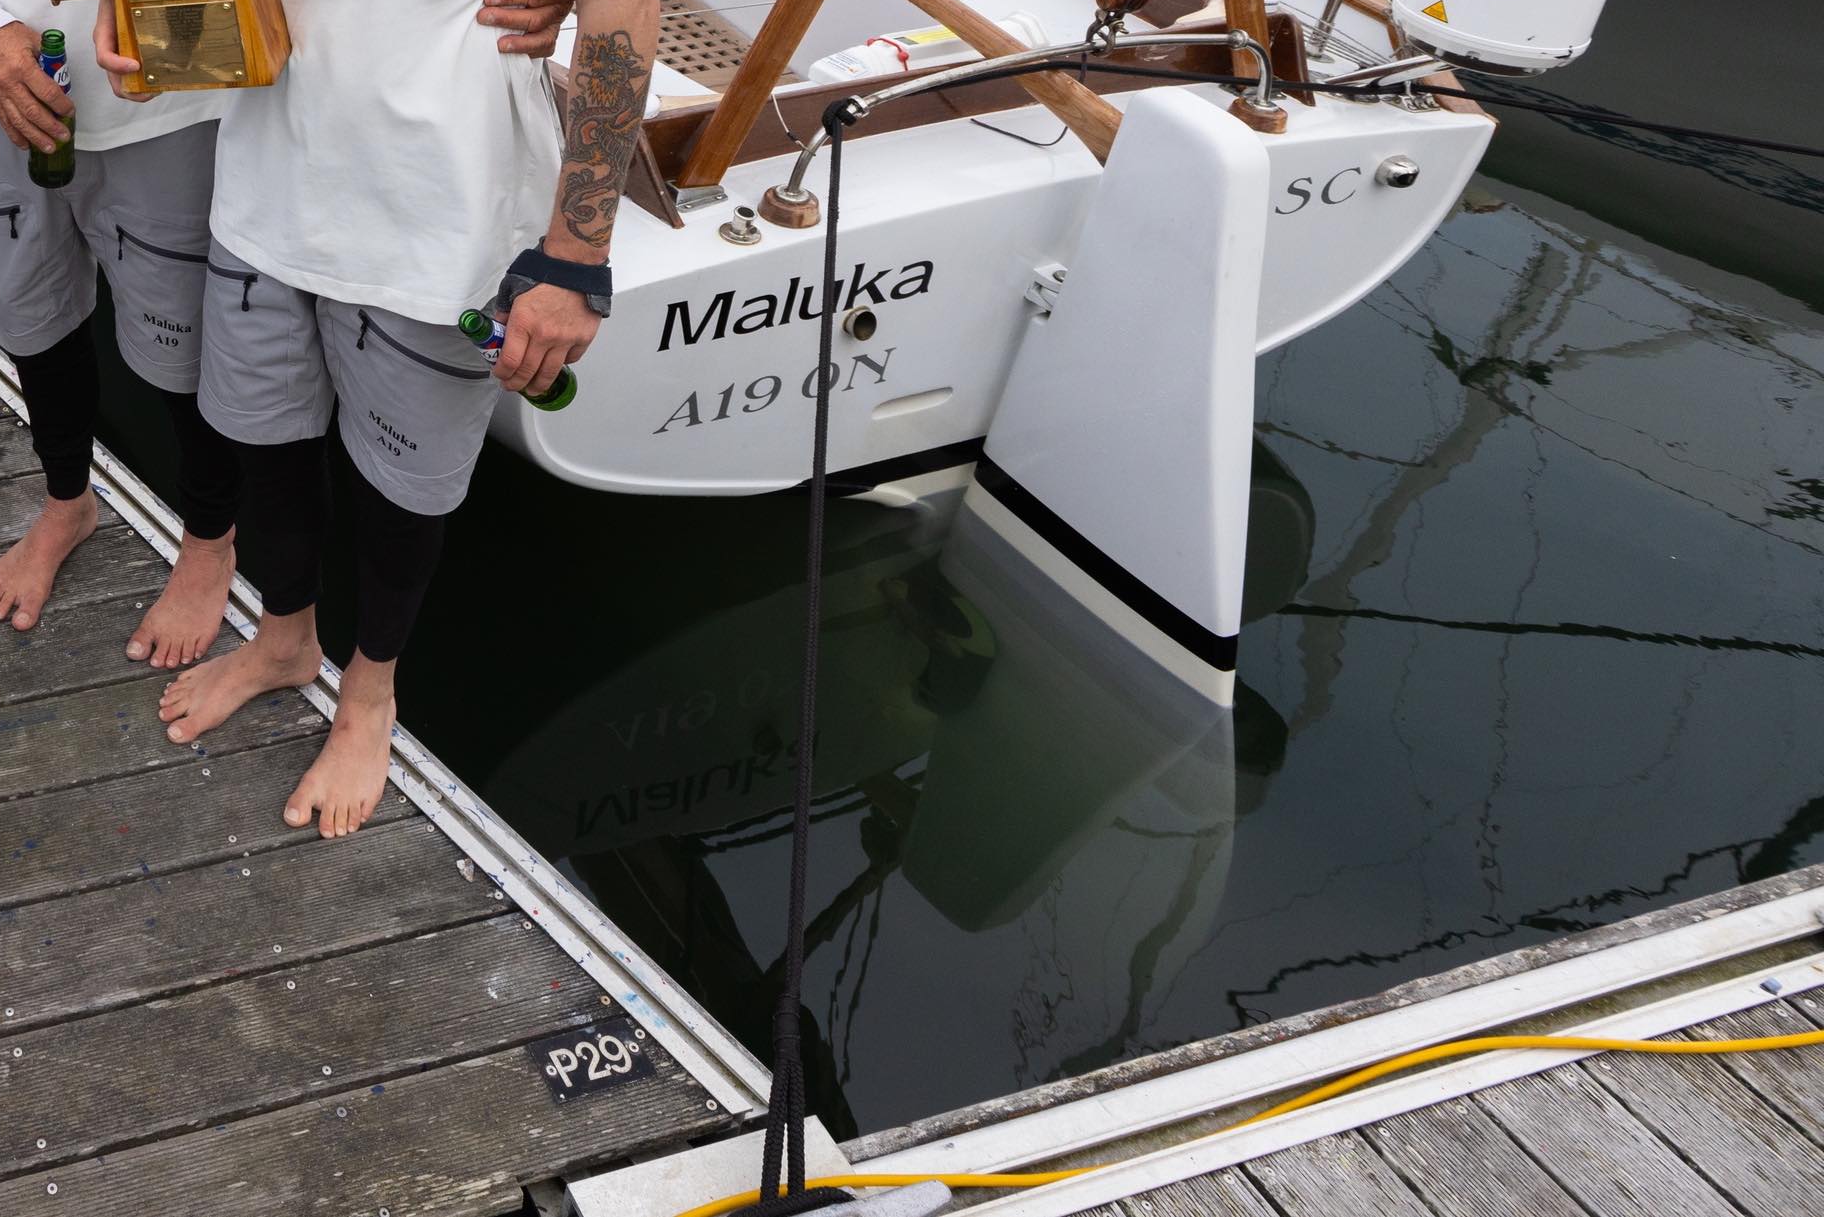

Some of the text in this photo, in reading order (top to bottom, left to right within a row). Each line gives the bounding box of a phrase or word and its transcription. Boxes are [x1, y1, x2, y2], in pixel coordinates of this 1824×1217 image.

[1275, 167, 1362, 215] SC
[143, 313, 193, 333] Maluka
[656, 259, 934, 353] Maluka
[153, 333, 179, 348] A19
[652, 375, 783, 435] A19
[368, 410, 417, 451] Maluka
[376, 435, 401, 457] A19
[548, 1034, 633, 1088] P29
